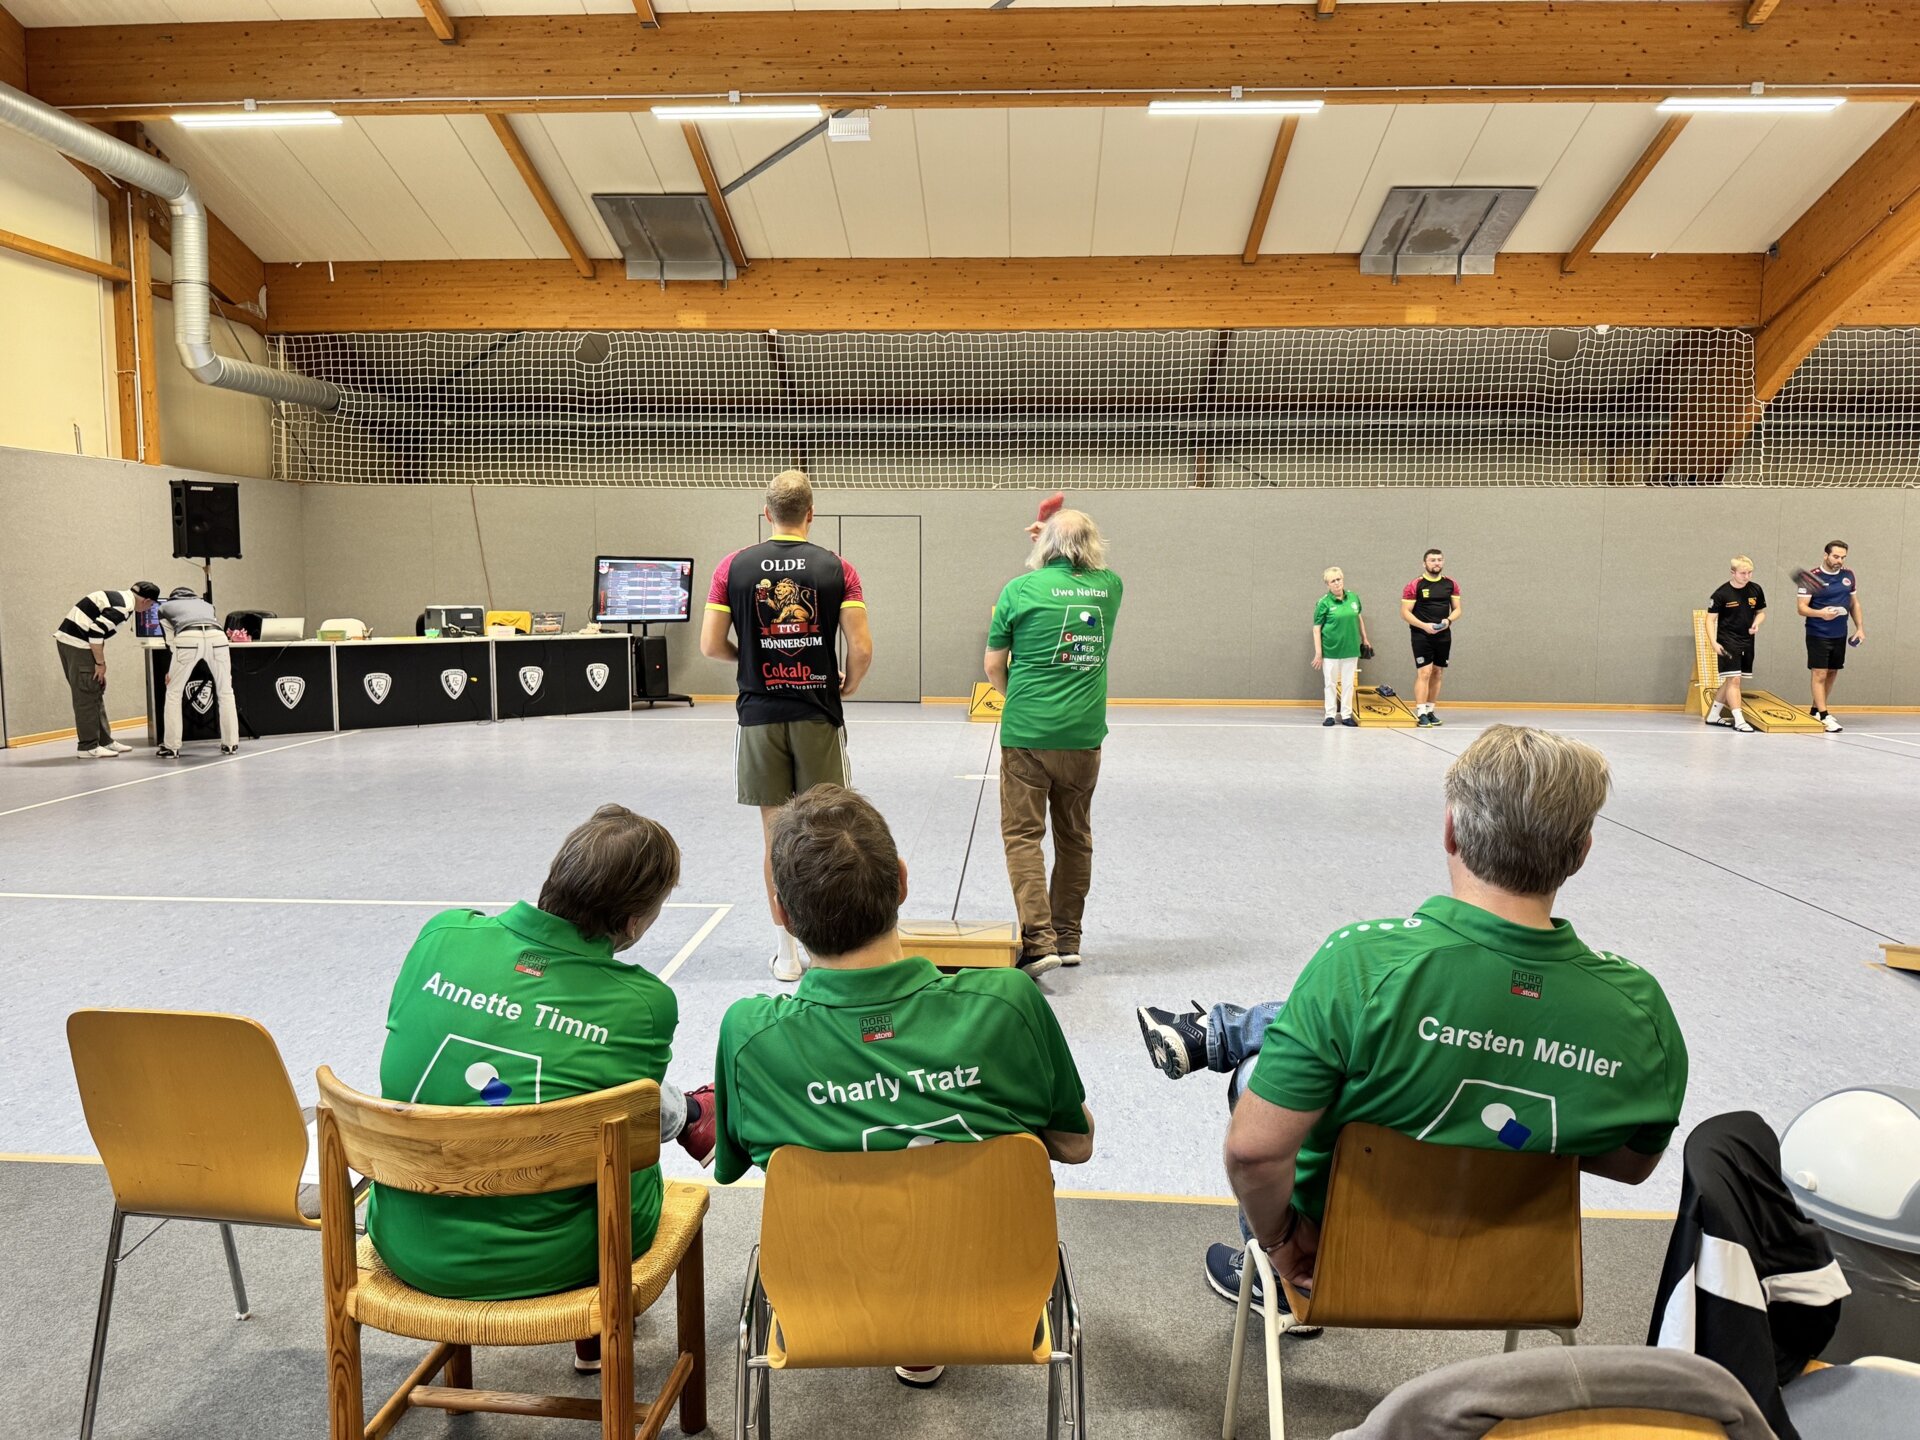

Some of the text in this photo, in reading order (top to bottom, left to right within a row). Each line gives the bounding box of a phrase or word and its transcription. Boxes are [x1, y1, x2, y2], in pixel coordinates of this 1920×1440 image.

[761, 559, 806, 572] OLDE
[1051, 588, 1108, 598] Uwe Neitzel
[777, 624, 800, 634] TTG
[760, 636, 823, 649] HÖNNERSUM
[1065, 633, 1102, 643] CORNHOLE
[762, 661, 811, 680] Cokalp
[422, 971, 609, 1045] Annette Timm
[1418, 1016, 1623, 1079] Carsten Möller
[806, 1064, 982, 1105] Charly Tratz
